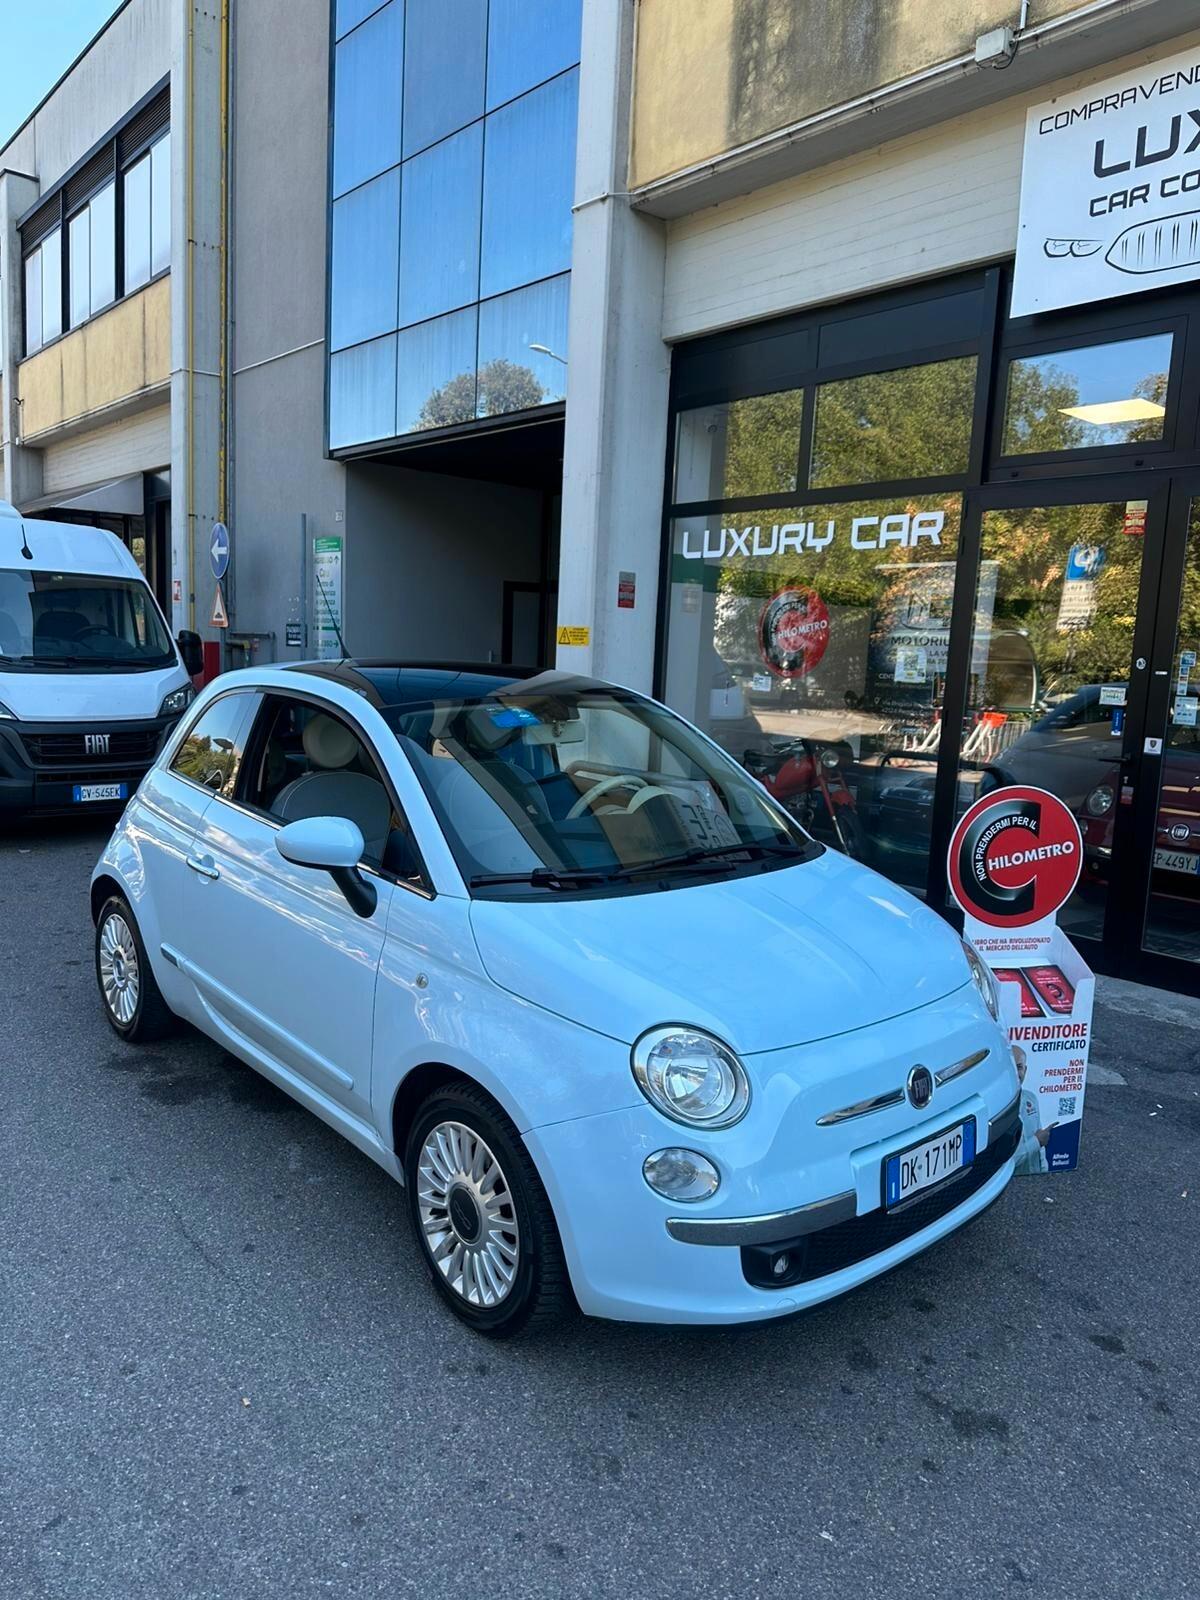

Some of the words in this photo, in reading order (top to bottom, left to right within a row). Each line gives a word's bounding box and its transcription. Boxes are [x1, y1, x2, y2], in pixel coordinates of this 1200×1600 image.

[1089, 184, 1150, 217] CAR
[682, 520, 834, 559] LUXURY
[851, 511, 944, 550] CAR
[84, 734, 111, 754] FIAT
[1012, 816, 1029, 826] PER
[1029, 819, 1037, 830] IL
[975, 817, 1011, 860] PRENDERMI
[988, 841, 1075, 871] HILOMETRO
[975, 861, 988, 881] NON
[1007, 1023, 1087, 1041] IVENDITORE
[1031, 1039, 1086, 1052] CERTIFICATO
[1069, 1059, 1084, 1067] NON
[1044, 1067, 1084, 1077] PRENDERMI
[1063, 1075, 1076, 1083] PER
[1039, 1083, 1082, 1093] CHILOMETRO
